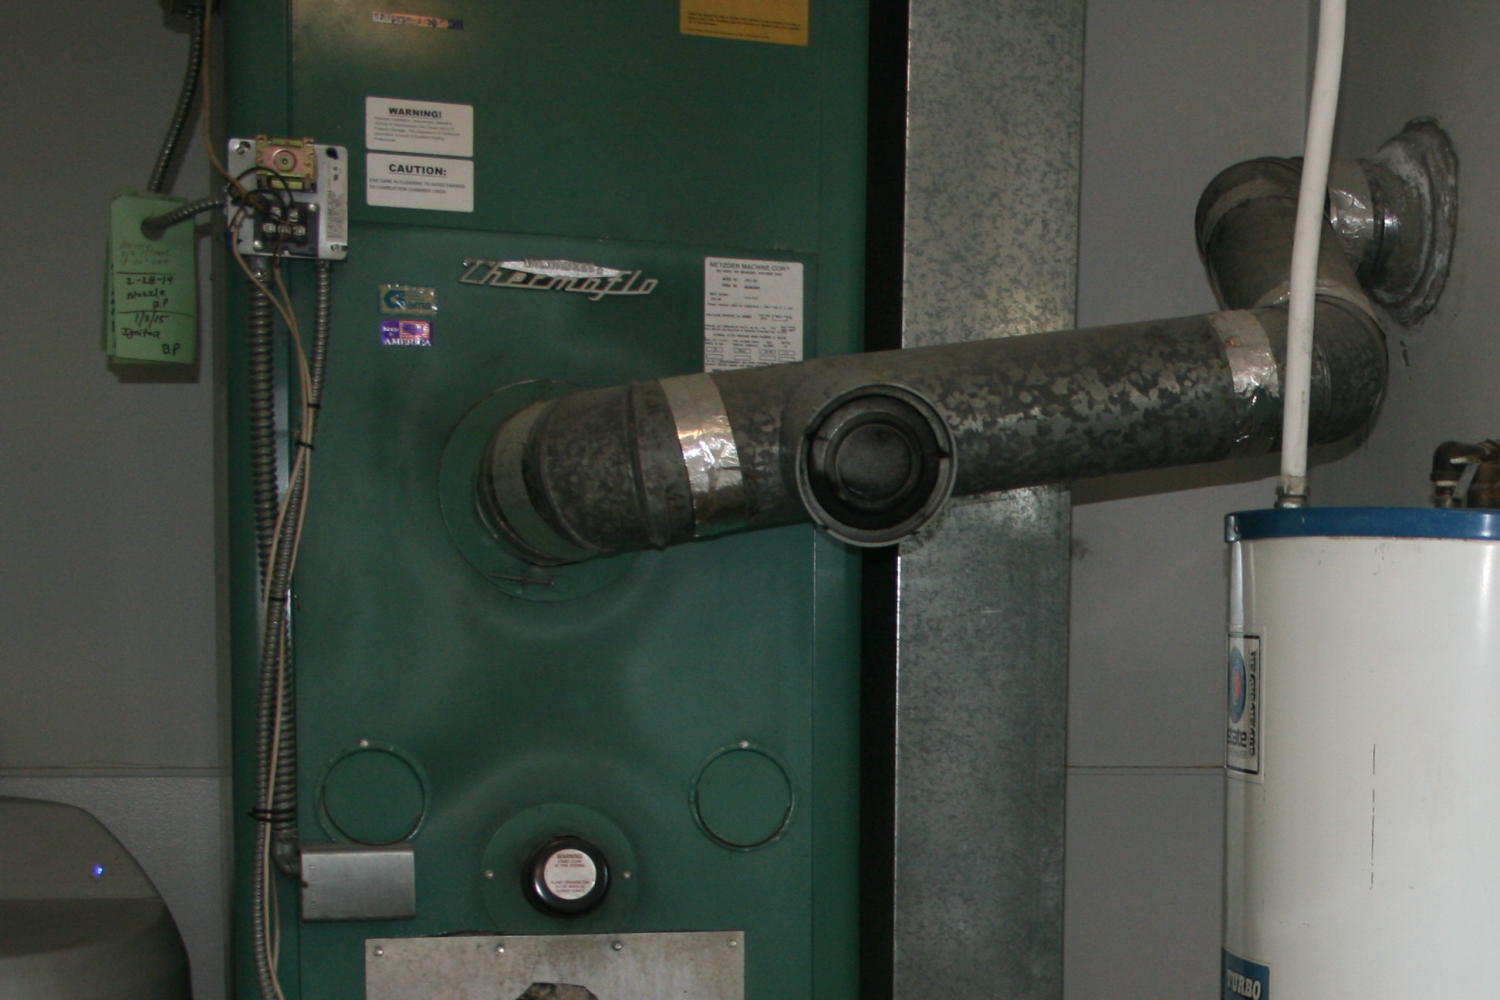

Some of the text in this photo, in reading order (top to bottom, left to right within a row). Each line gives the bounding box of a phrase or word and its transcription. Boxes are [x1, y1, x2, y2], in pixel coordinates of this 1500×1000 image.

[388, 107, 442, 118] WARNING!
[388, 163, 447, 177] CAUTION:
[459, 258, 659, 301] Thermoflo
[1226, 969, 1262, 1000] TURBO
